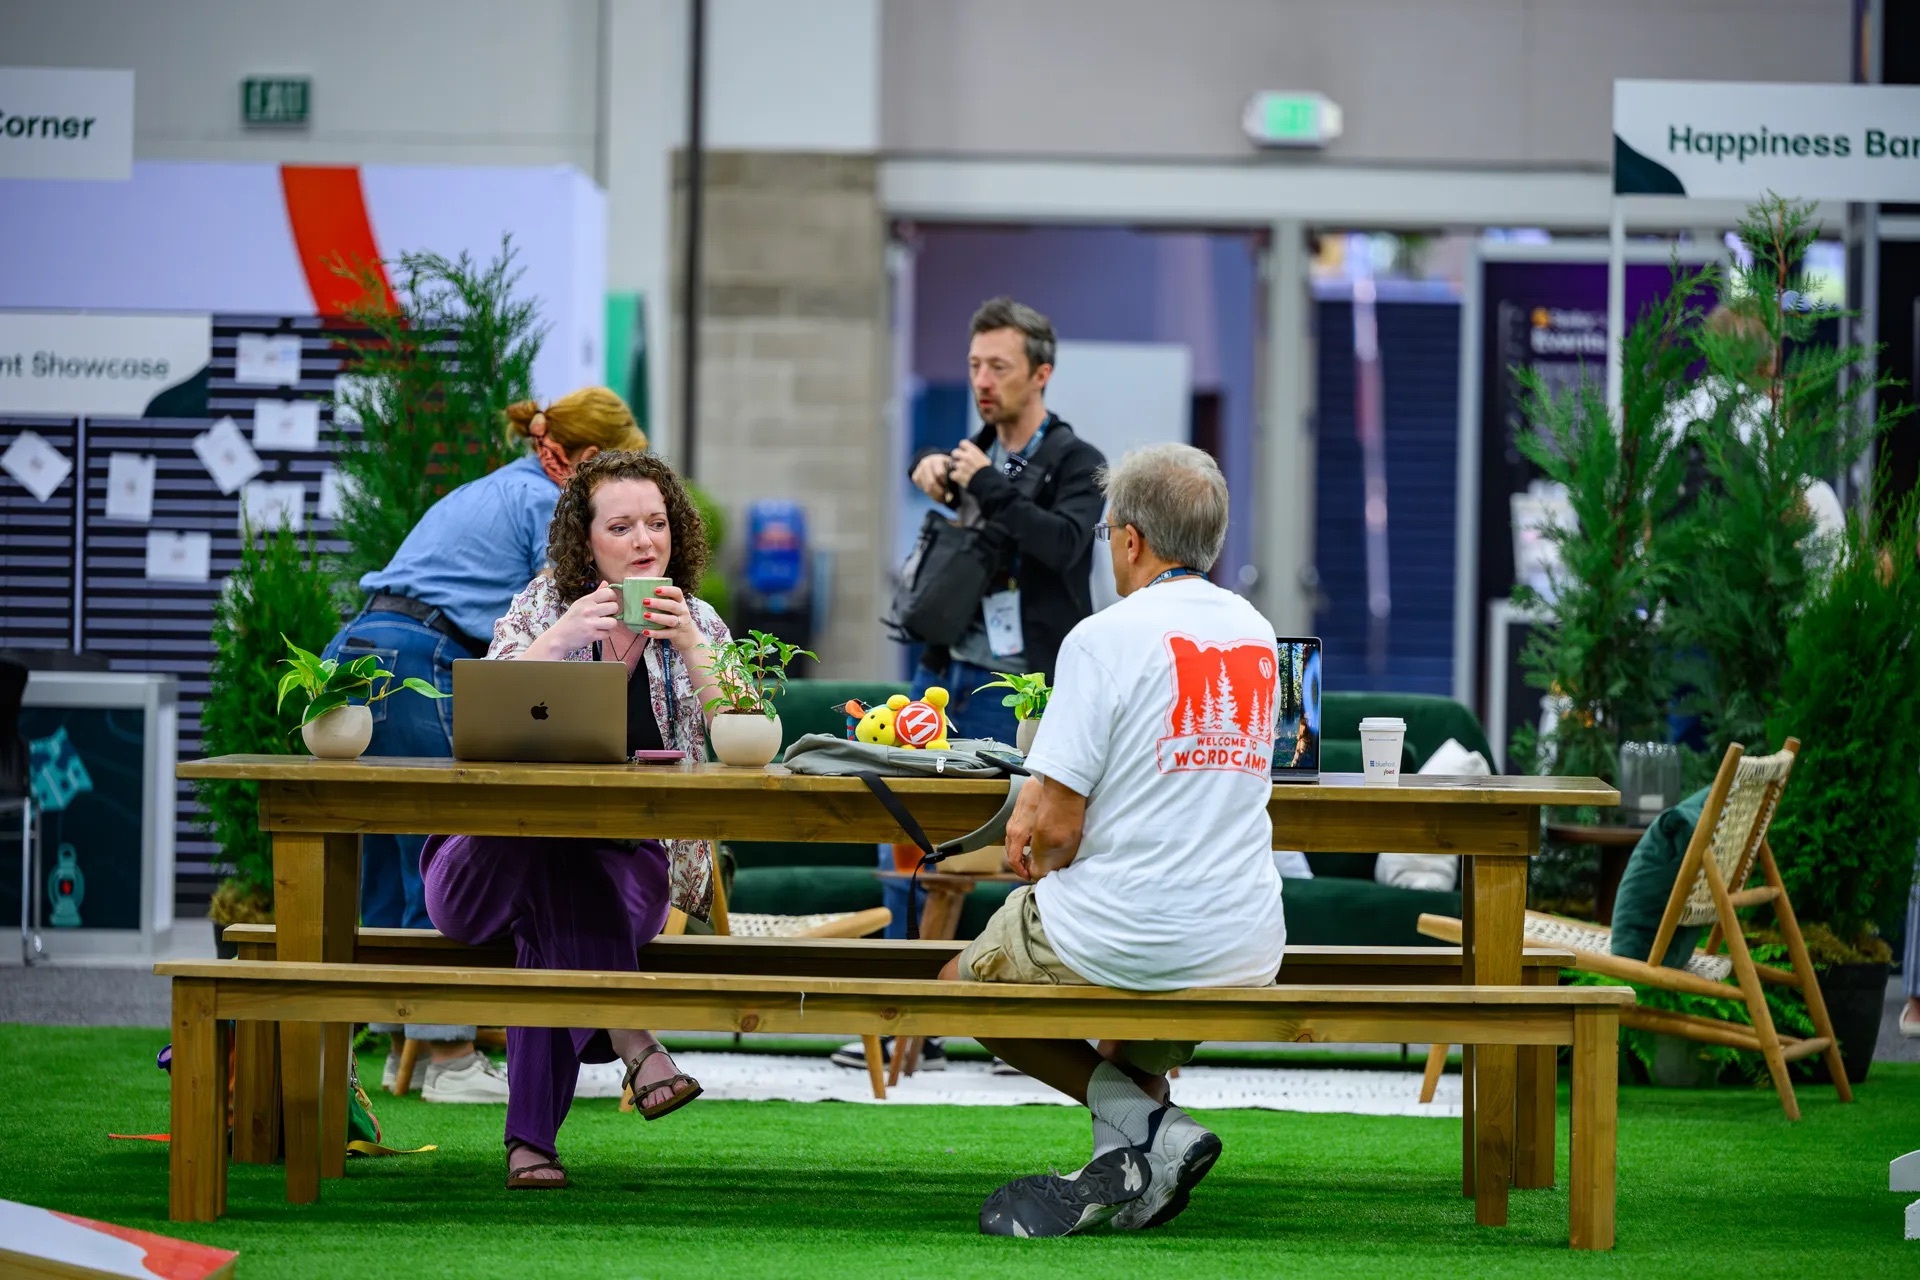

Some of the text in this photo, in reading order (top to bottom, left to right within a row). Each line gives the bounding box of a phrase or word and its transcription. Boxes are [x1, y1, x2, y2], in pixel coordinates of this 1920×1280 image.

[0, 109, 96, 139] orner
[1669, 125, 1851, 162] Happiness
[32, 350, 169, 379] Showcase
[1197, 736, 1258, 751] WELCOME TO
[1174, 750, 1267, 772] WORDCAMP
